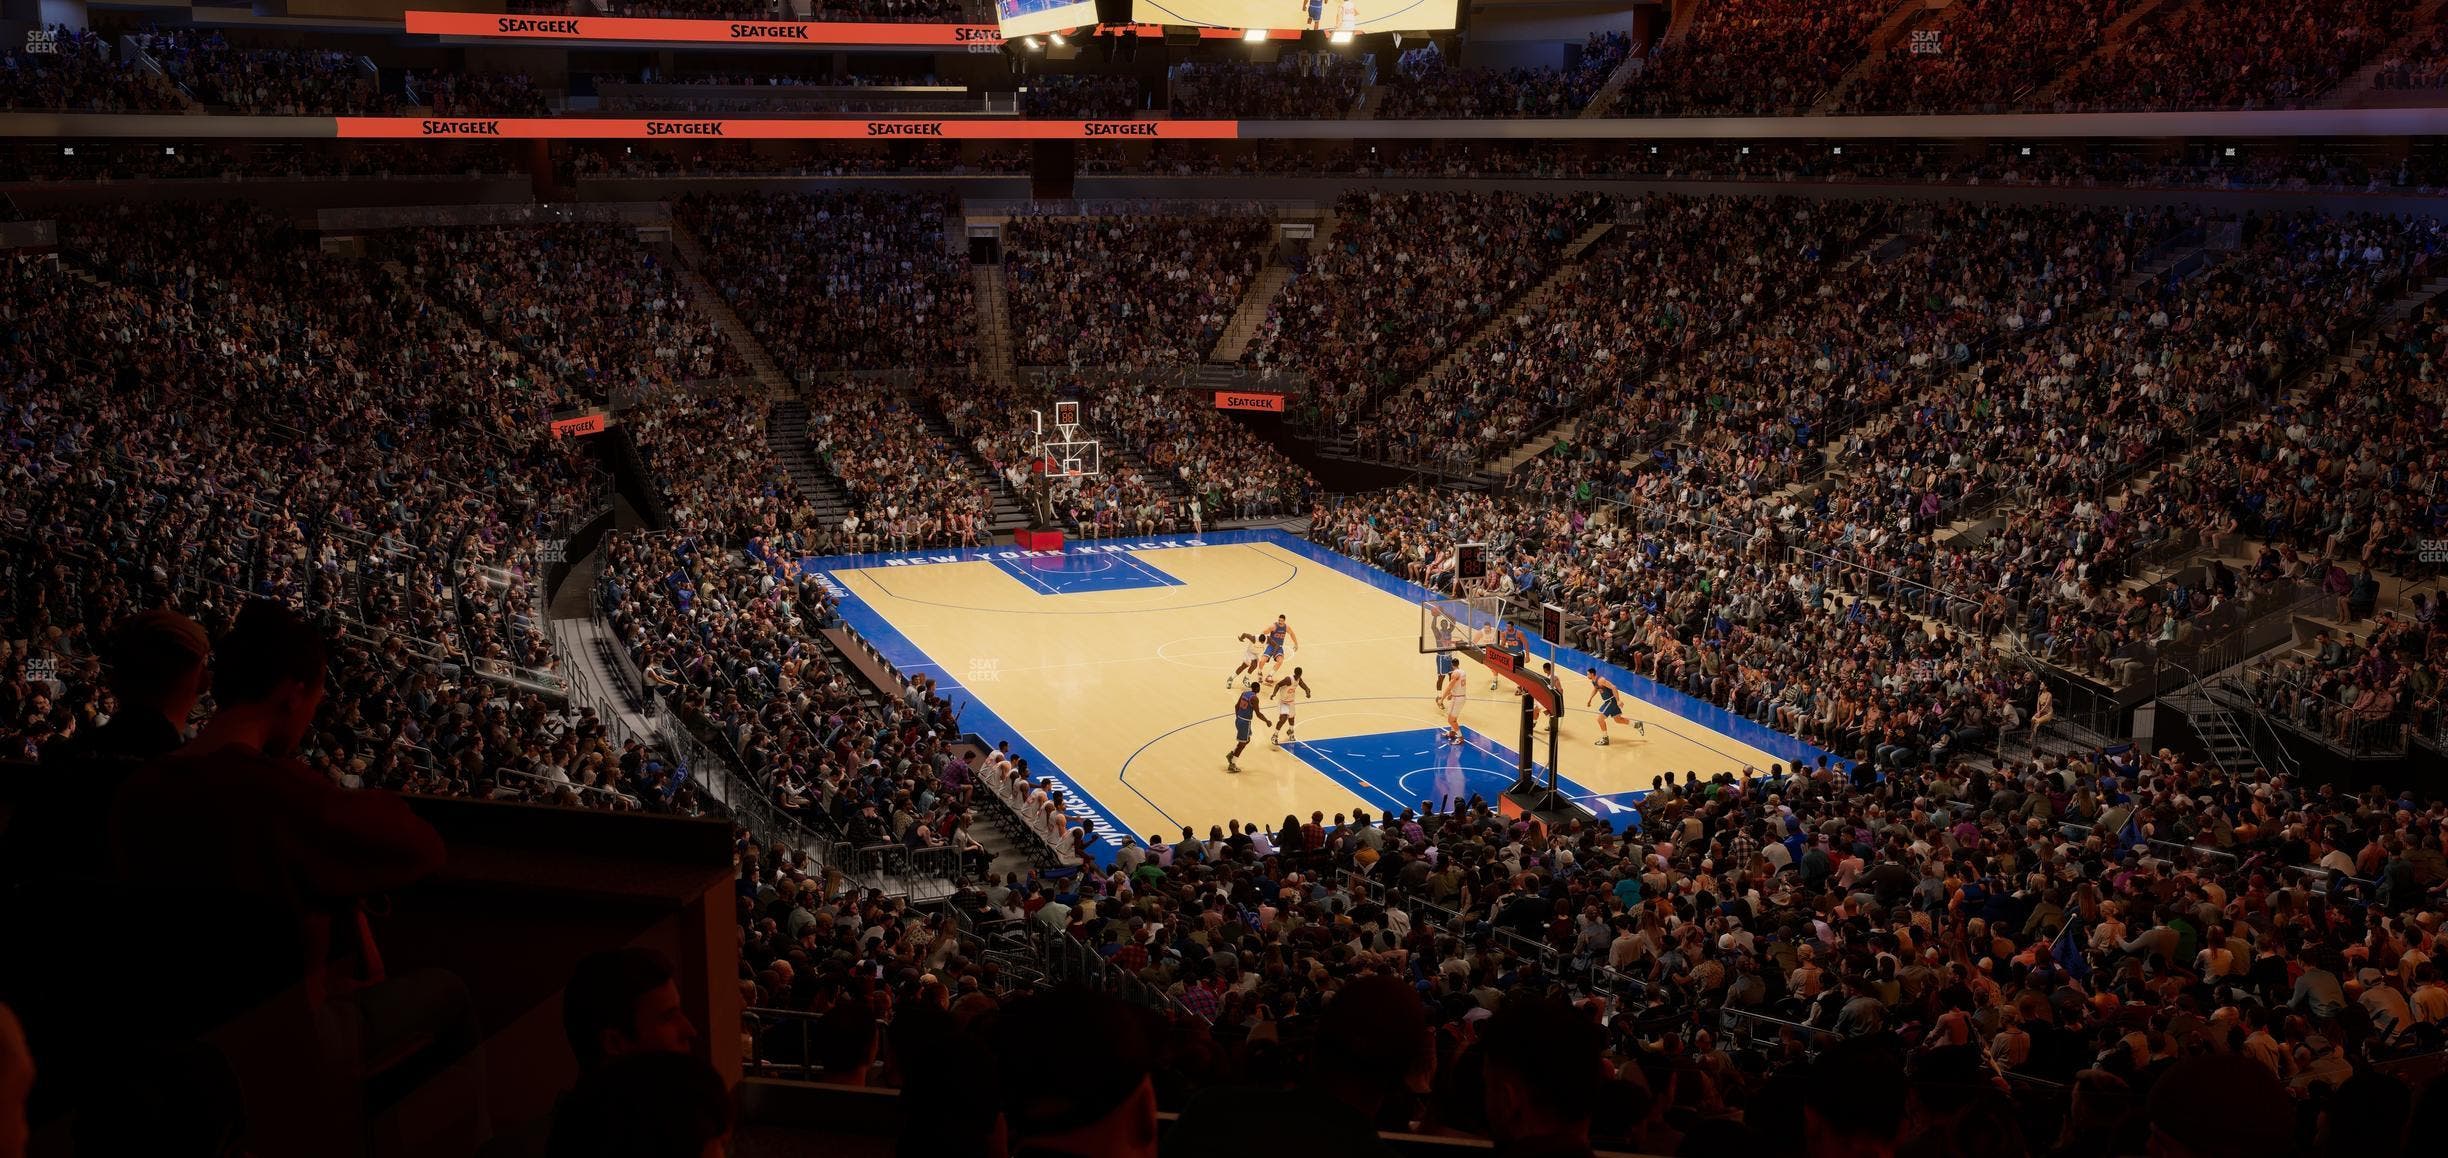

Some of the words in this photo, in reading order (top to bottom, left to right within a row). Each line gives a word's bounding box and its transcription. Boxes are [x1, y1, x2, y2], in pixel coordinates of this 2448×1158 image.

[498, 18, 580, 34] SEATGEEK
[731, 24, 808, 39] SEATGEEK
[956, 28, 1001, 41] SEATG
[422, 120, 500, 136] SEATGEEK
[646, 122, 723, 136] SEATGEEK
[867, 122, 943, 136] SEATGEEK
[1084, 122, 1158, 136] SEATGEEK
[1227, 396, 1273, 408] SEATGEEK
[885, 555, 958, 566] NEW
[1076, 540, 1208, 554] KNICKS
